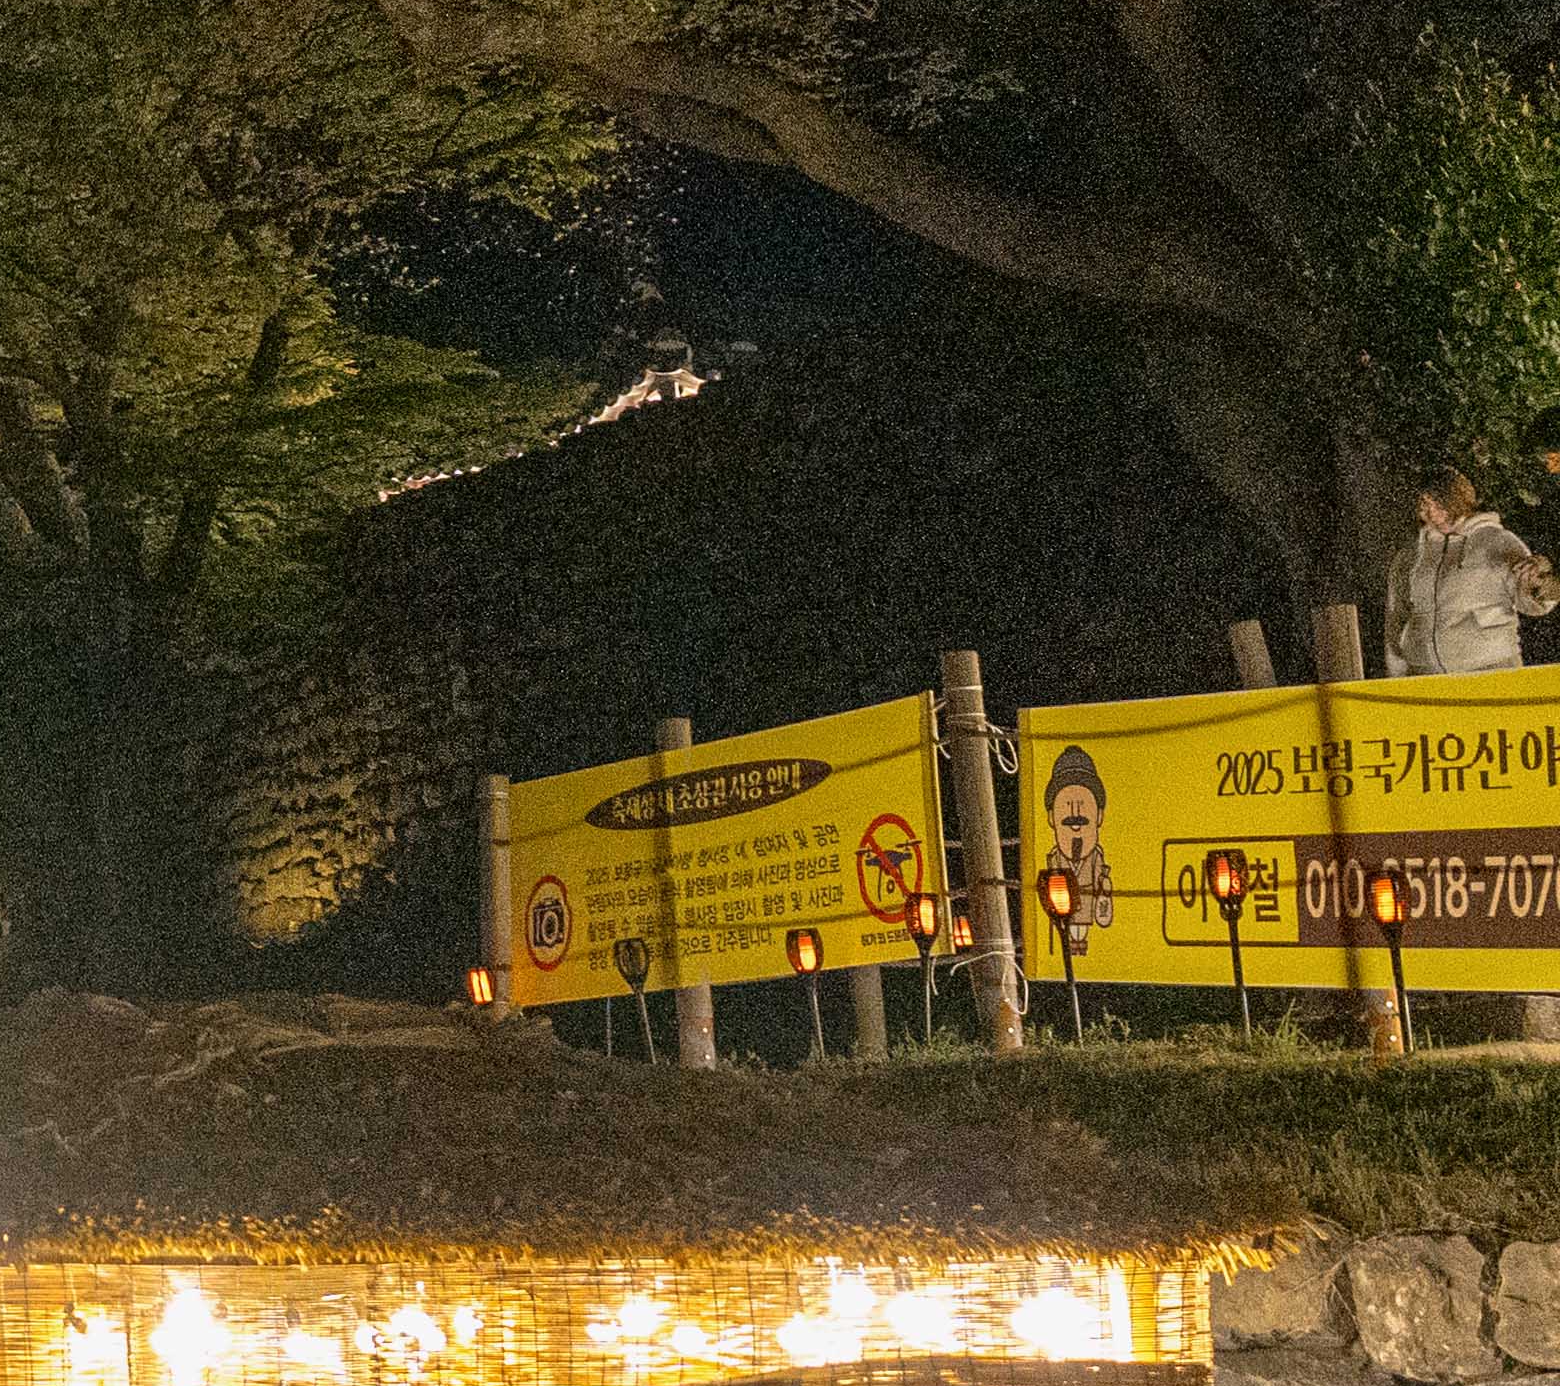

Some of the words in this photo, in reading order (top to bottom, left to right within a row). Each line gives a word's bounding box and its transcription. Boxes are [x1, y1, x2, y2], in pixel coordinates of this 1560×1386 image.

[729, 770, 763, 801] 사용
[765, 761, 802, 795] 안내
[1216, 748, 1285, 798] 2025
[1290, 738, 1355, 799] 보령
[1358, 728, 1513, 795] 국가유산
[812, 823, 841, 847] 공연
[757, 861, 792, 887] 사진과
[794, 853, 841, 882] 영상으로
[1178, 857, 1281, 924] 이철
[1305, 853, 1560, 920] 010518-707
[722, 897, 757, 922] 입장시
[762, 893, 785, 917] 촬영
[790, 889, 803, 913] 및
[808, 883, 845, 909] 사진과
